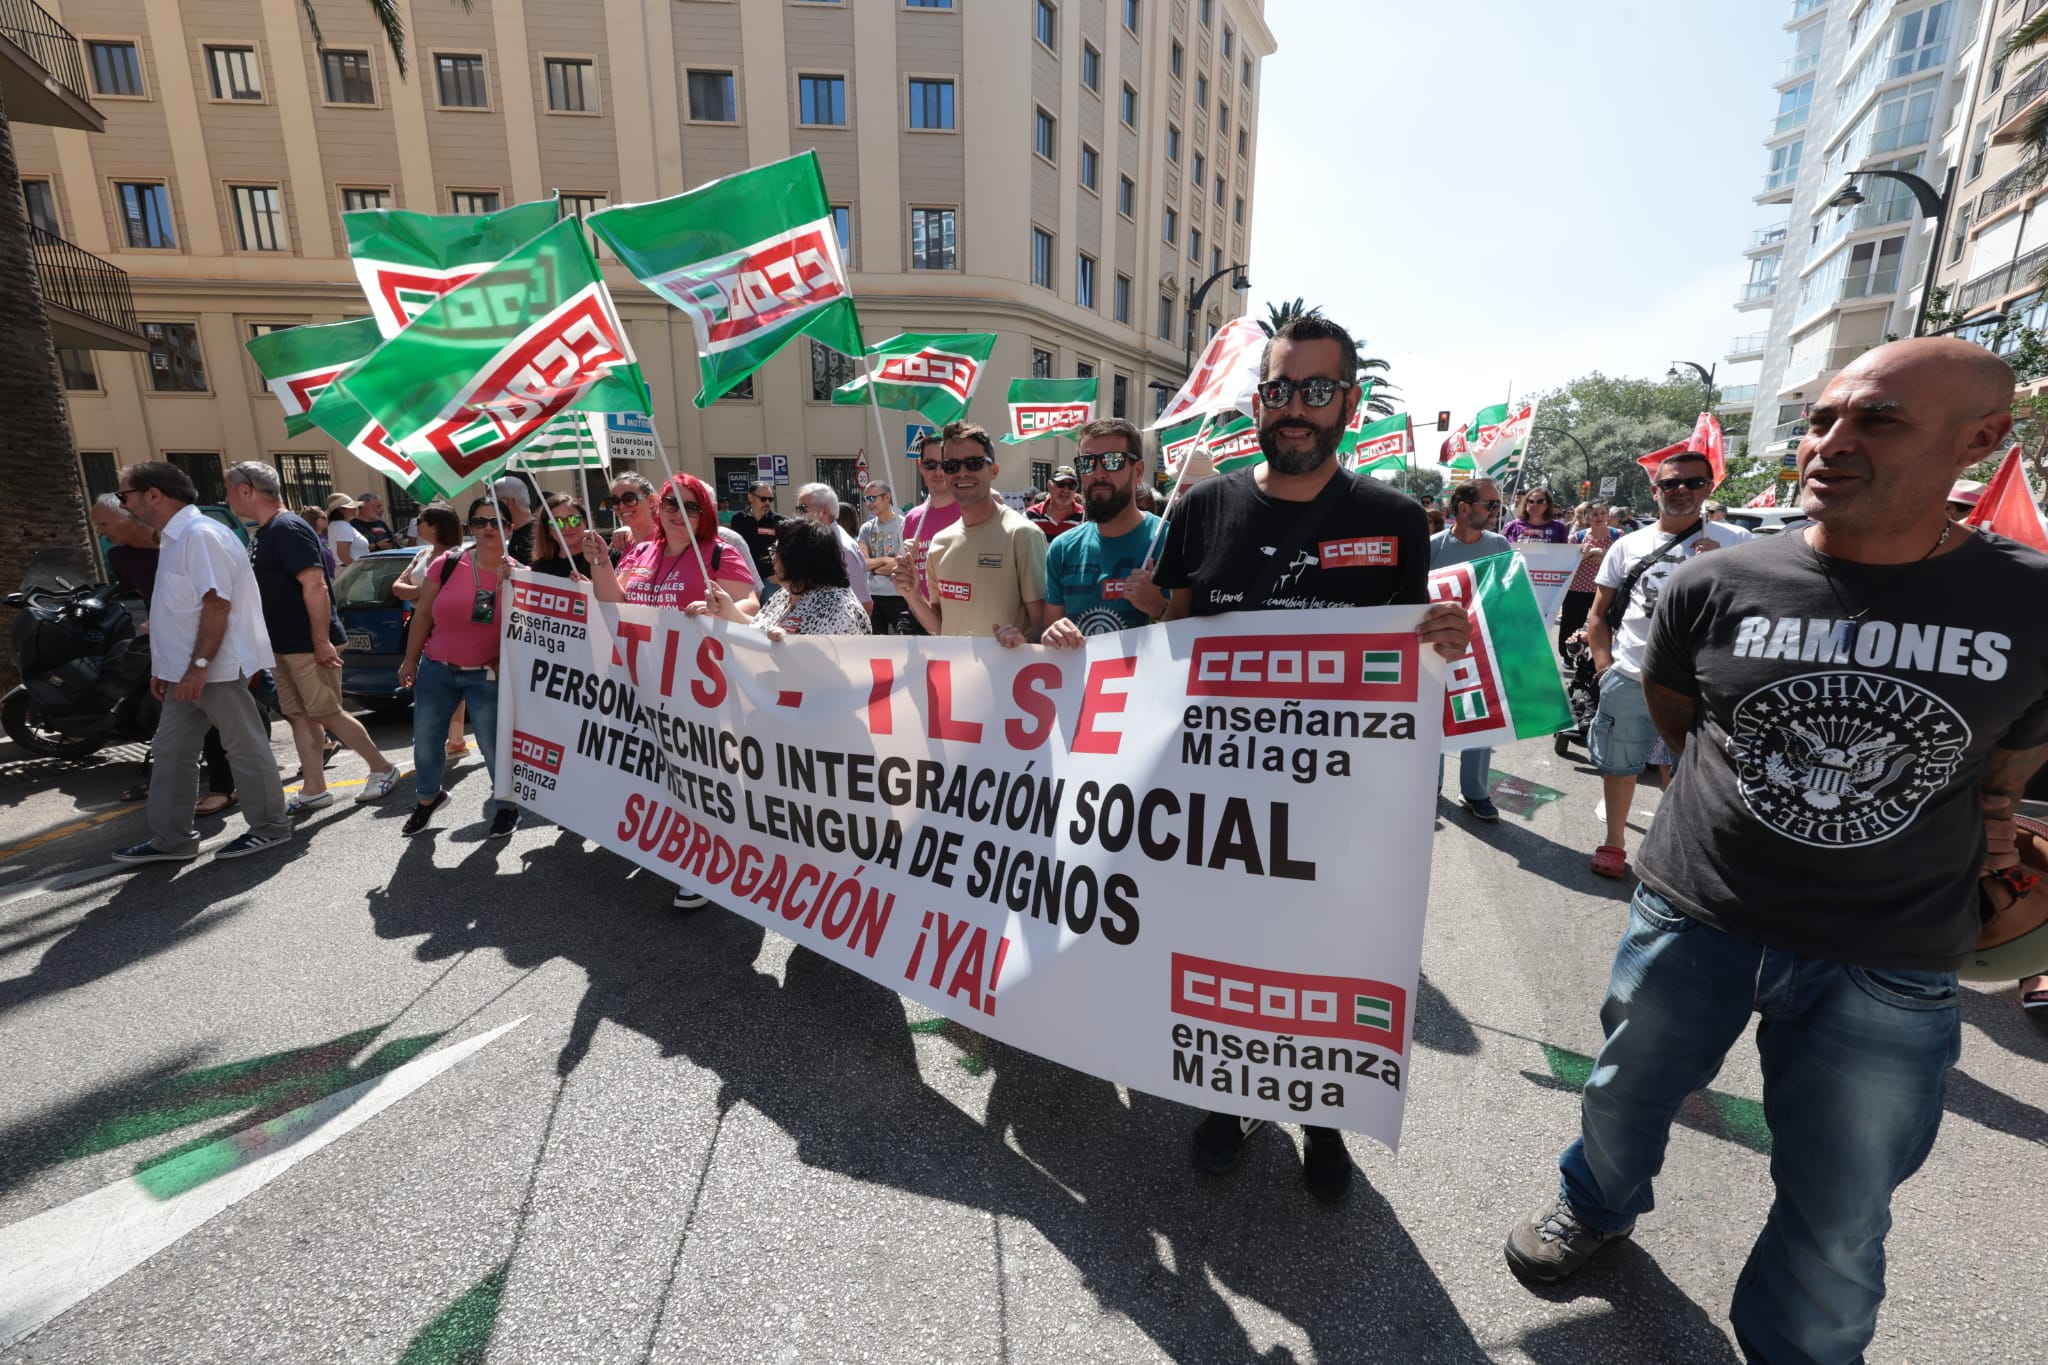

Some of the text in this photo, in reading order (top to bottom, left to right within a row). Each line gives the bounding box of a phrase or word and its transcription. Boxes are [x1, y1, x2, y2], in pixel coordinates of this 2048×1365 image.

[627, 418, 650, 428] MOTOS
[611, 435, 653, 446] Laborables
[612, 447, 621, 455] de
[636, 448, 645, 456] 20
[774, 456, 786, 472] P
[1323, 541, 1380, 558] CCOO
[514, 587, 569, 612] CCOO
[665, 593, 677, 603] EN
[1105, 582, 1125, 593] CC
[1210, 589, 1221, 604] El
[1309, 597, 1326, 609] las
[506, 624, 566, 653] Málaga
[510, 611, 586, 641] enseñanza
[1732, 616, 2012, 682] RAMONES
[1198, 650, 1345, 684] CCOO
[867, 656, 1138, 755] ILSE
[1770, 674, 1946, 725] JOHNNY
[1183, 700, 1417, 740] enseñanza
[1181, 731, 1351, 784] Málaga
[1922, 734, 1964, 791] JOEY
[513, 764, 557, 791] eñanza
[513, 781, 537, 802] aga
[775, 742, 1066, 838] INTEGRACIÓN
[1069, 780, 1316, 881] SOCIAL
[744, 789, 902, 870] LENGUA
[908, 825, 965, 888] DE
[966, 839, 1141, 947] SIGNOS
[903, 910, 1011, 1017] ¡YA!
[1183, 970, 1338, 1023] CCOO
[1171, 1023, 1400, 1092] enseñanza
[1172, 1049, 1345, 1112] Málaga
